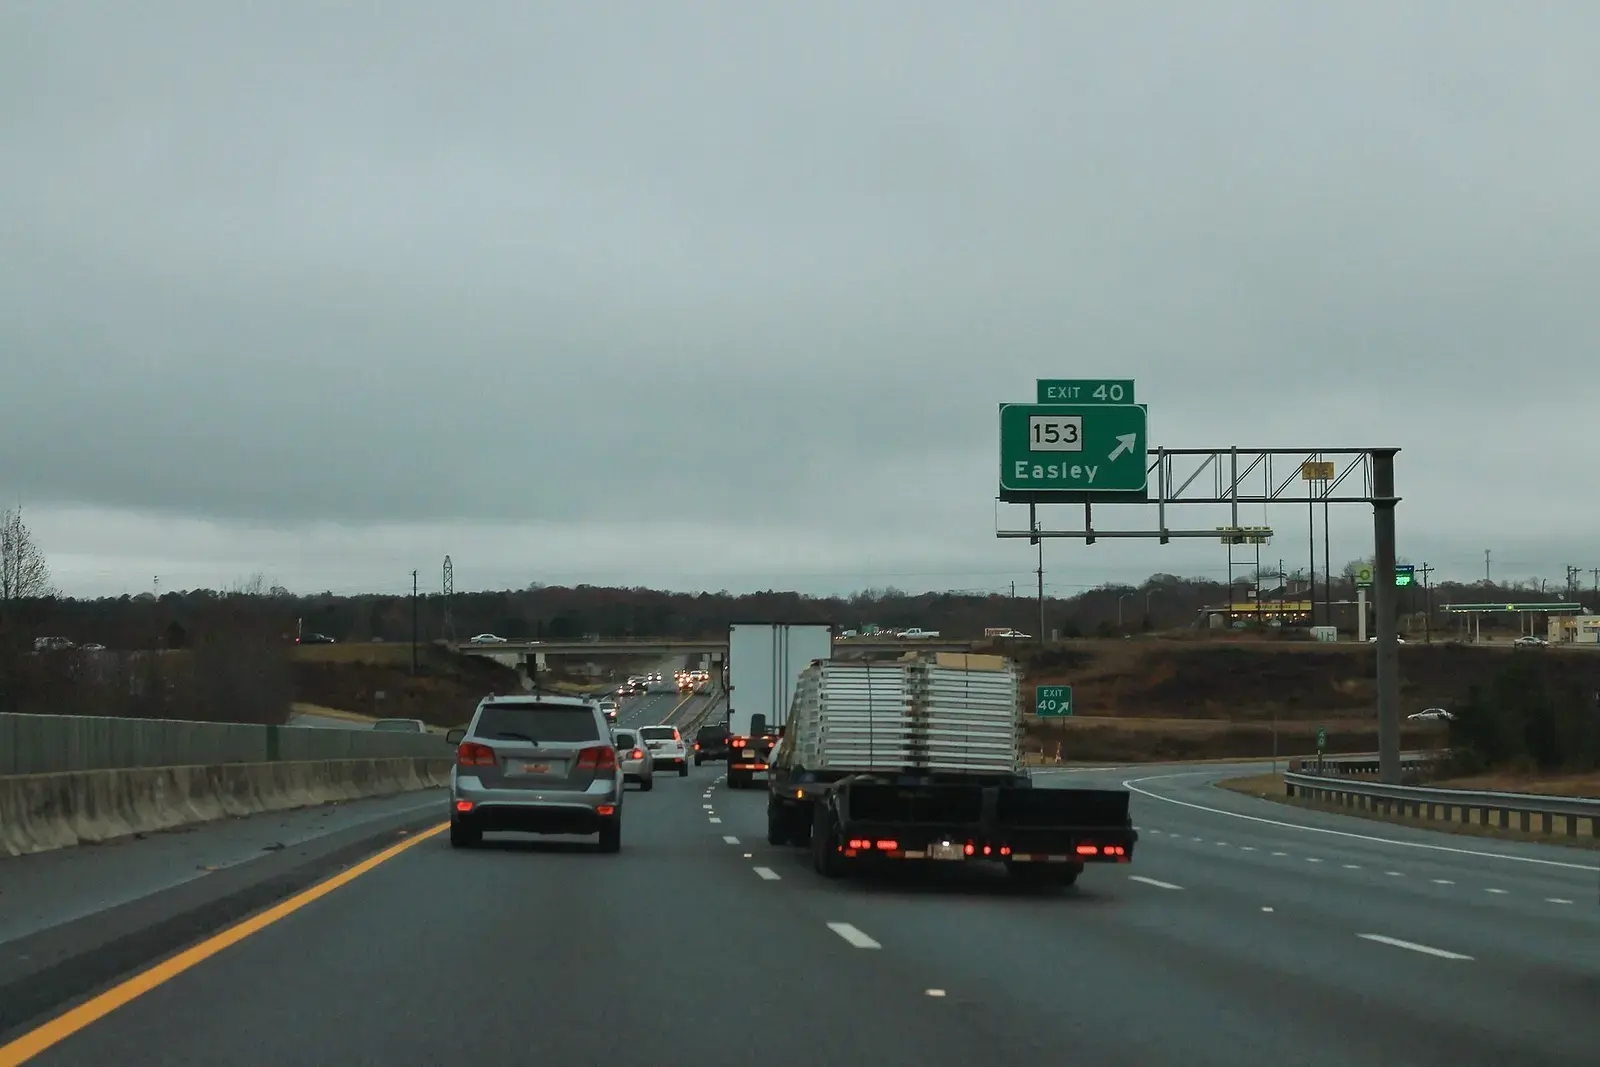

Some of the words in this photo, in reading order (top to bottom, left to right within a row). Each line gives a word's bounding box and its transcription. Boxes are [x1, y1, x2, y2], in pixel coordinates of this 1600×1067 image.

[1047, 386, 1081, 398] EXIT
[1092, 384, 1124, 401] 40
[1033, 423, 1078, 444] 153
[1014, 460, 1099, 484] Easley
[1043, 689, 1063, 697] EXIT
[1037, 699, 1057, 710] 40
